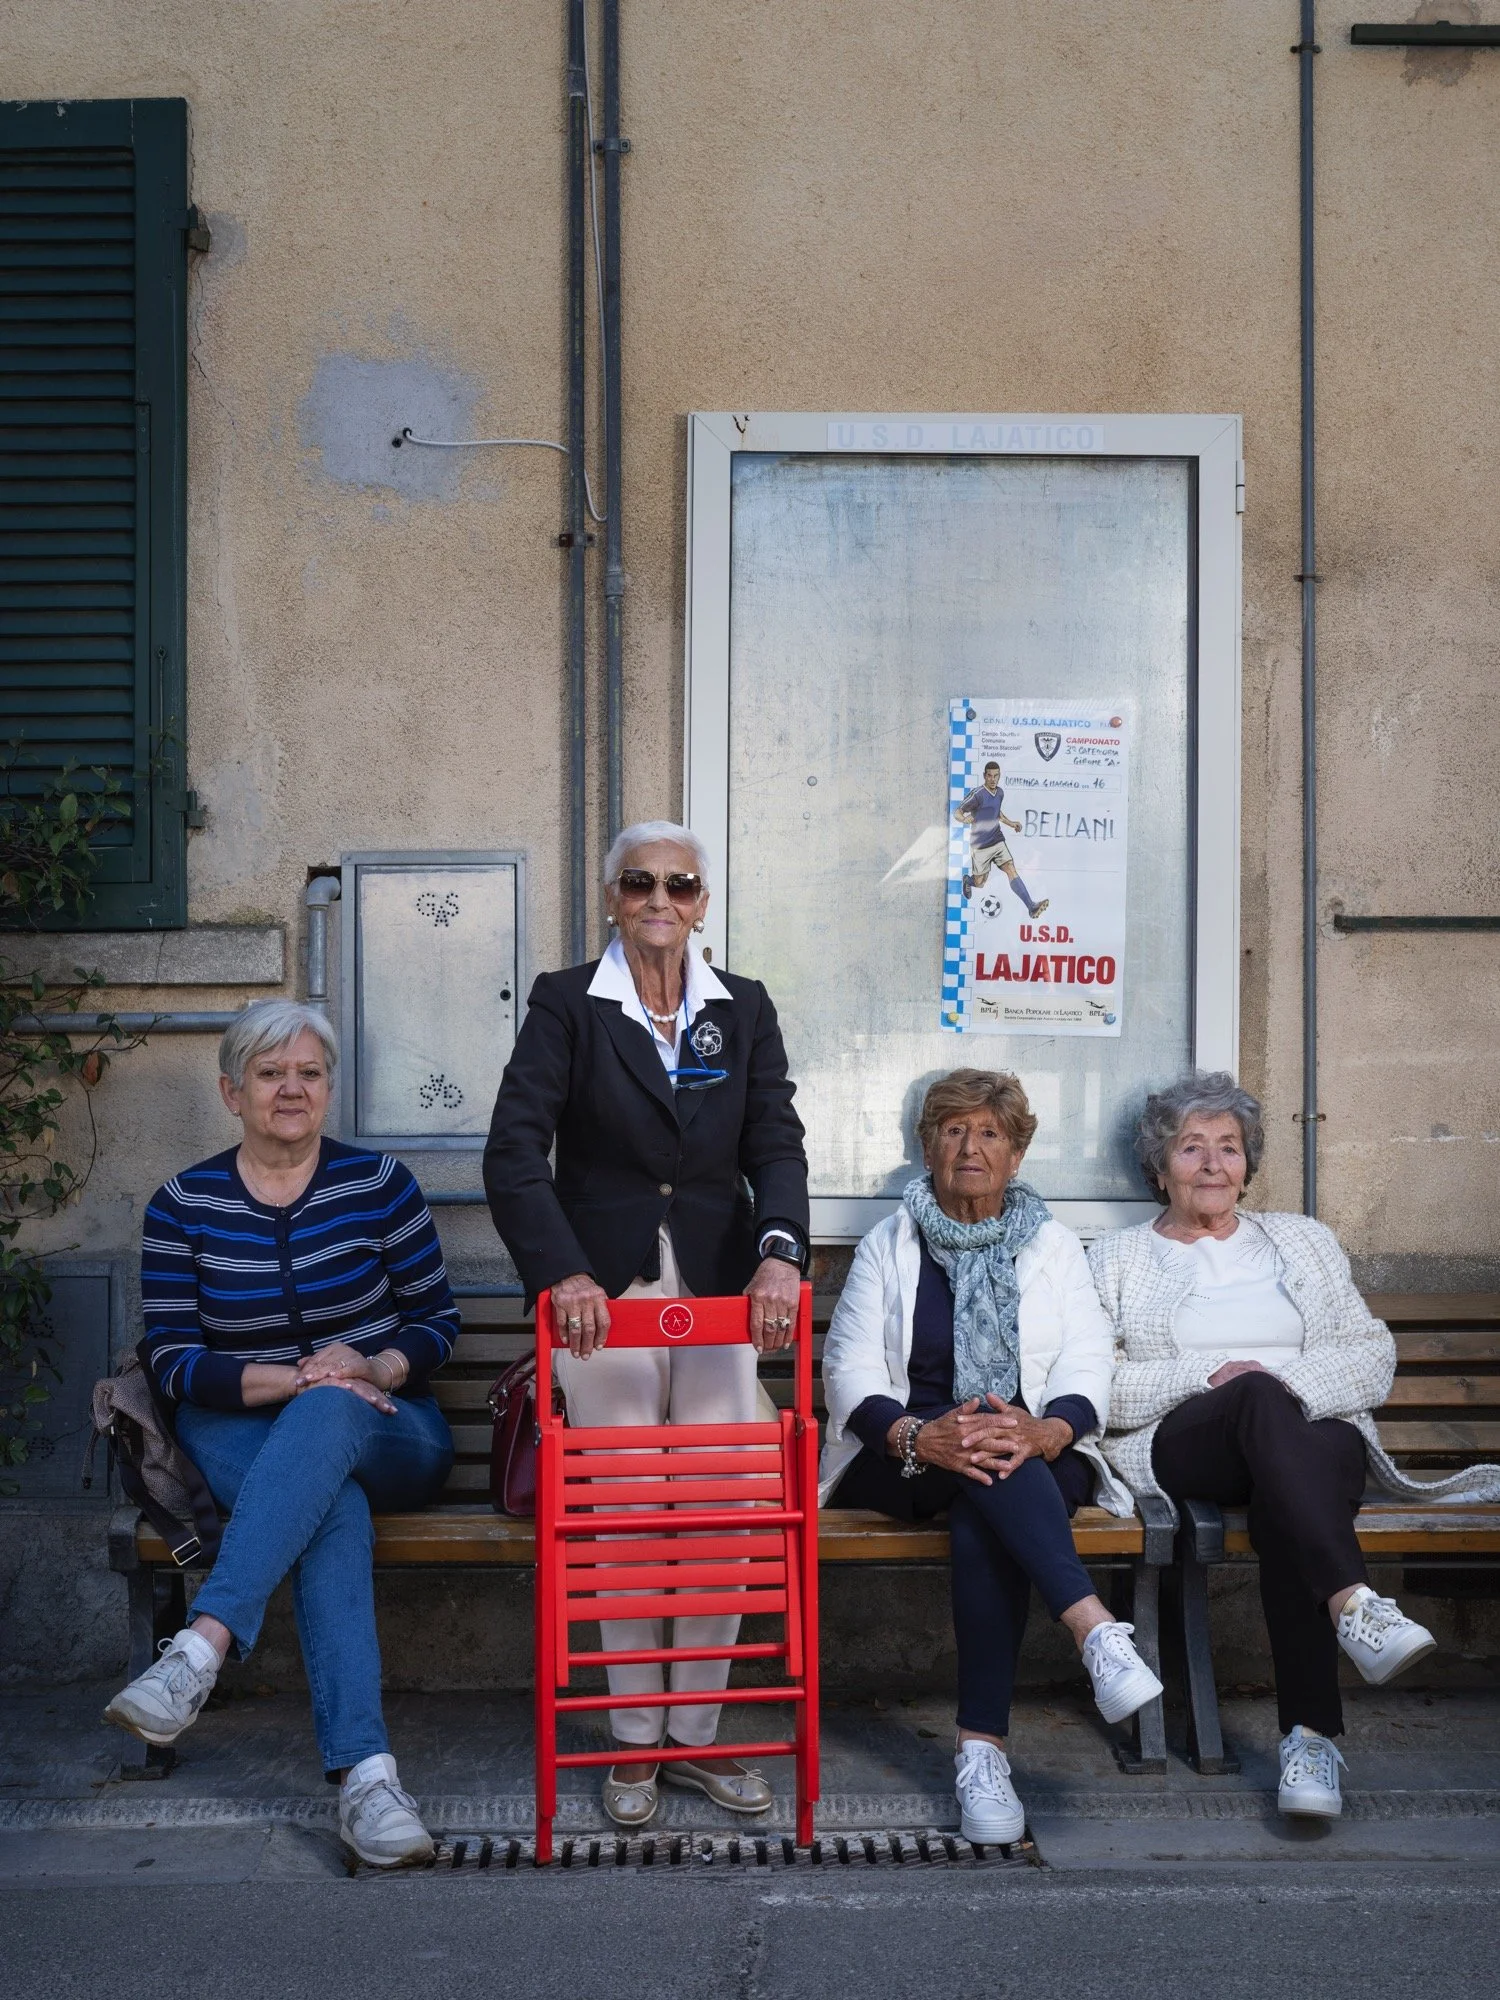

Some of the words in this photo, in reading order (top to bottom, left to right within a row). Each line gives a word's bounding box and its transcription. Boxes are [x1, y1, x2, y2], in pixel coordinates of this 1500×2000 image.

[836, 424, 935, 449] U.S.D.
[952, 425, 1095, 450] LAJATICO
[1011, 717, 1041, 726] U.S.D.
[1043, 718, 1091, 729] LAJATICO
[1065, 737, 1120, 746] CAMPIONATO
[1019, 924, 1074, 943] U.S.D.
[975, 952, 1116, 985] LAJATICO
